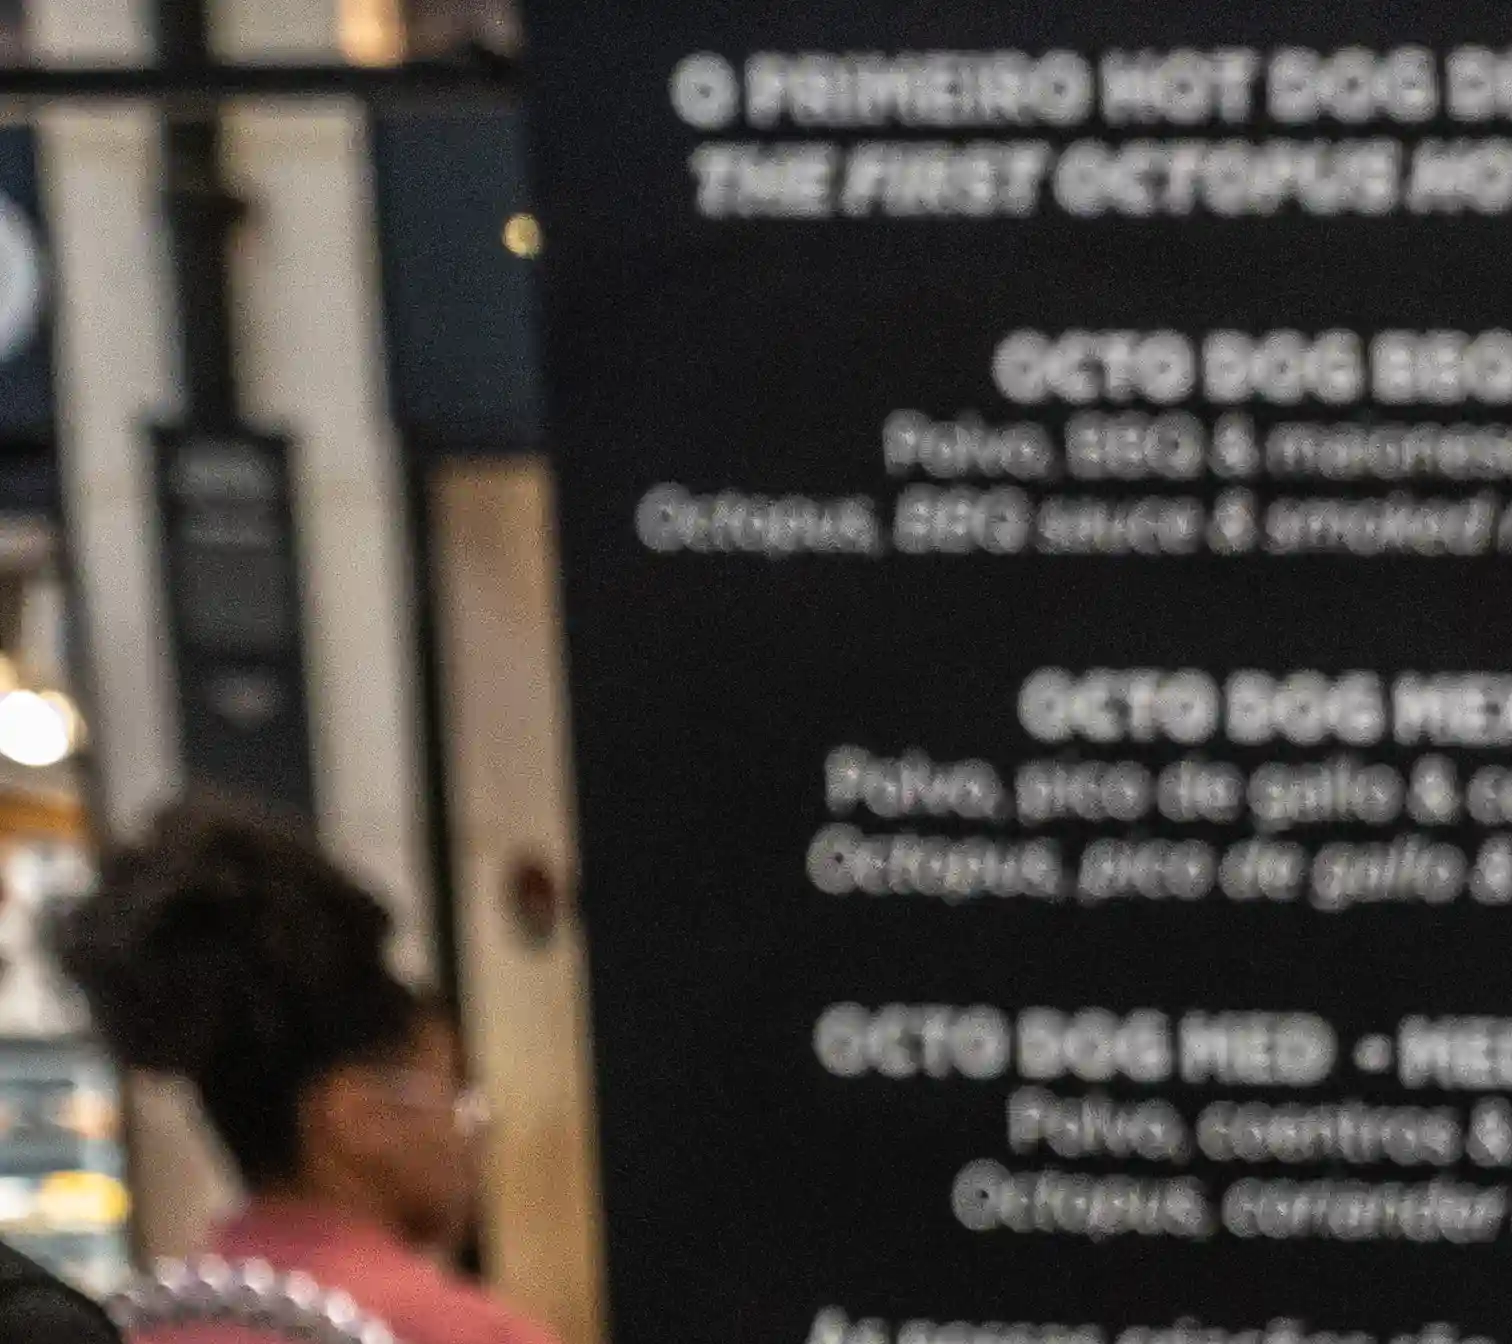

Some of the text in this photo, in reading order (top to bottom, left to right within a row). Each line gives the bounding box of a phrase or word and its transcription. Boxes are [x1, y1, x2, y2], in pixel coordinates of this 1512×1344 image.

[674, 57, 733, 124] O
[749, 52, 1091, 124] PRIMEIRO
[1101, 52, 1257, 121] HOT
[1269, 49, 1438, 120] DOG
[693, 145, 835, 213] THE
[841, 143, 1051, 213] FIRST
[1054, 141, 1402, 211] OCTOPUS
[996, 335, 1192, 401] OCTO
[1204, 333, 1361, 399] DOG
[1070, 417, 1204, 478] BBQ
[1210, 415, 1257, 478] &
[896, 490, 1032, 551] BBQ
[1035, 499, 1206, 551] sauce
[1207, 490, 1255, 551] &
[1262, 490, 1492, 553] smoked
[1022, 672, 1216, 739] OCTO
[1227, 674, 1384, 740] DOG
[1019, 762, 1149, 821] pico
[1159, 758, 1240, 817] de
[1409, 760, 1459, 821] &
[1080, 839, 1214, 902] pico
[1223, 839, 1304, 899] de
[817, 1007, 1008, 1072] OCTO
[1019, 1011, 1171, 1077] DOG
[1180, 1015, 1334, 1081] MED
[1226, 1180, 1510, 1242] coriander
